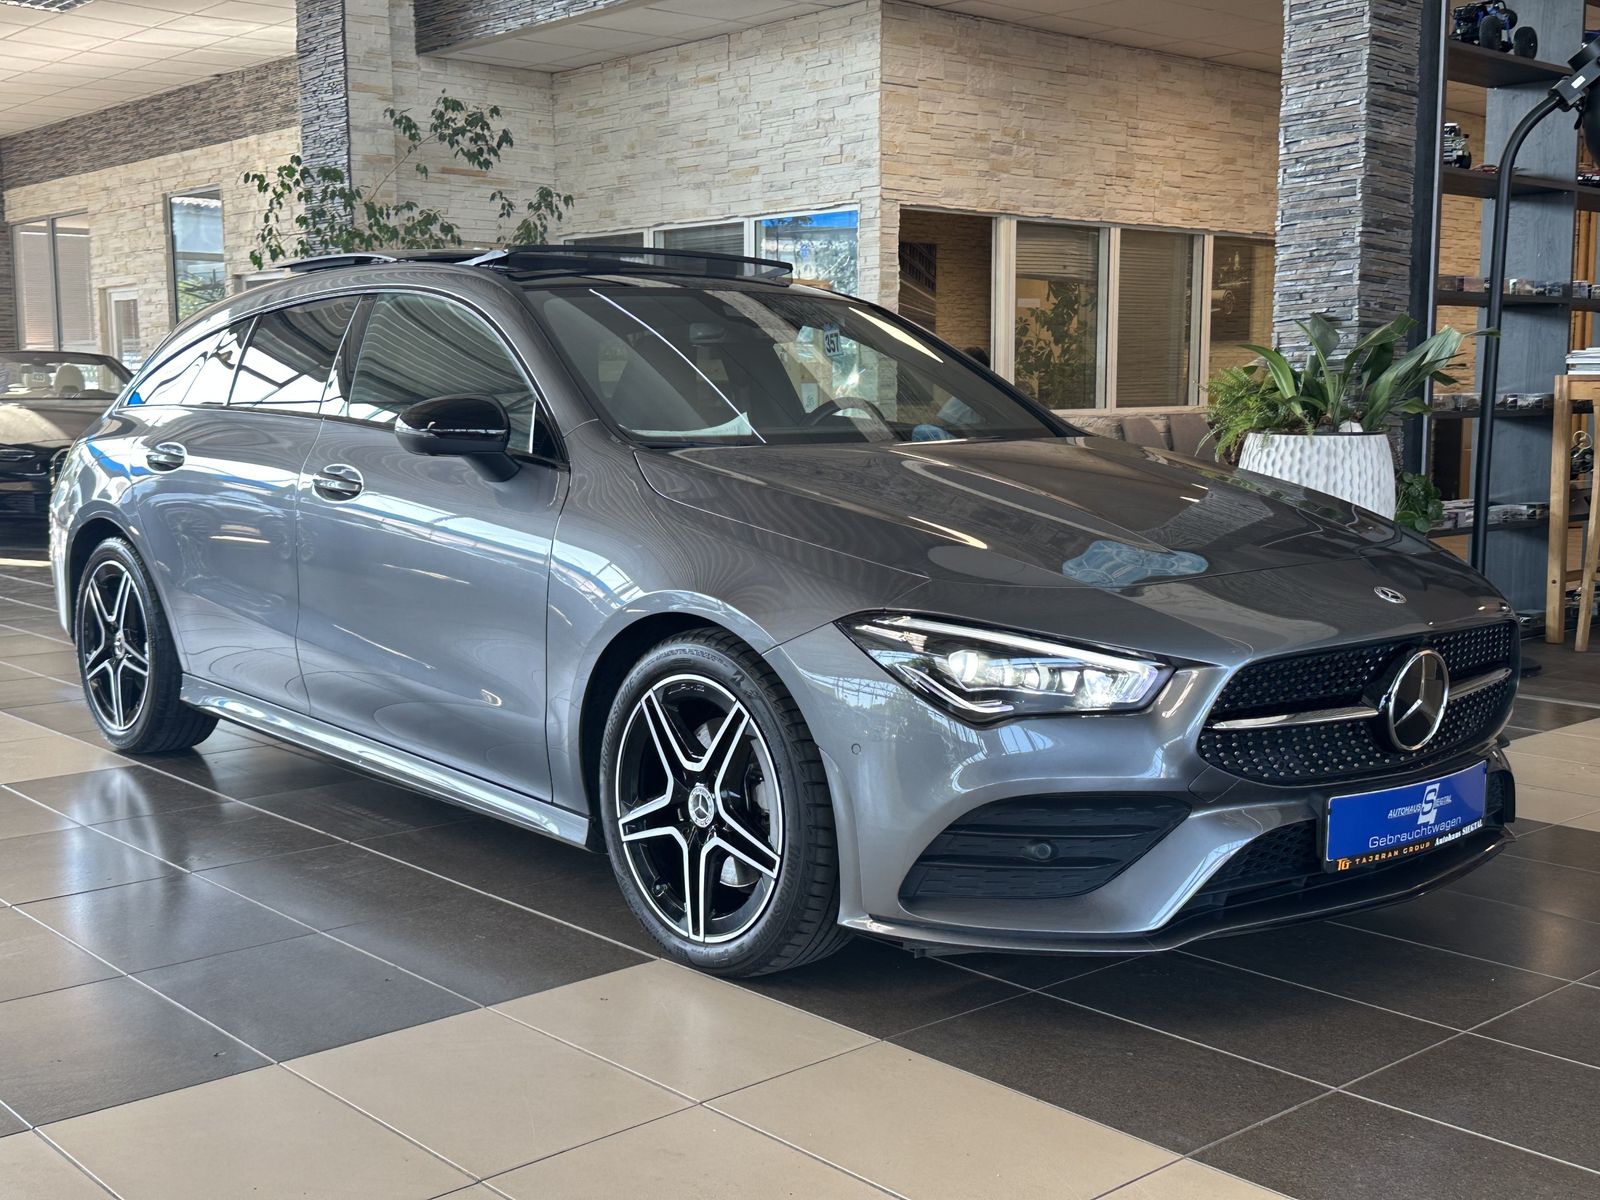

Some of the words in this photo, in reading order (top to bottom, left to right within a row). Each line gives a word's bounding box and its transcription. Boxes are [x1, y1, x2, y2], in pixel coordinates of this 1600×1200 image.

[825, 333, 839, 353] 357
[1355, 850, 1399, 865] TAJERAN
[1402, 841, 1431, 854] GROUP
[1434, 830, 1461, 847] Autohaus
[1368, 816, 1462, 848] Gebrauchtwagen
